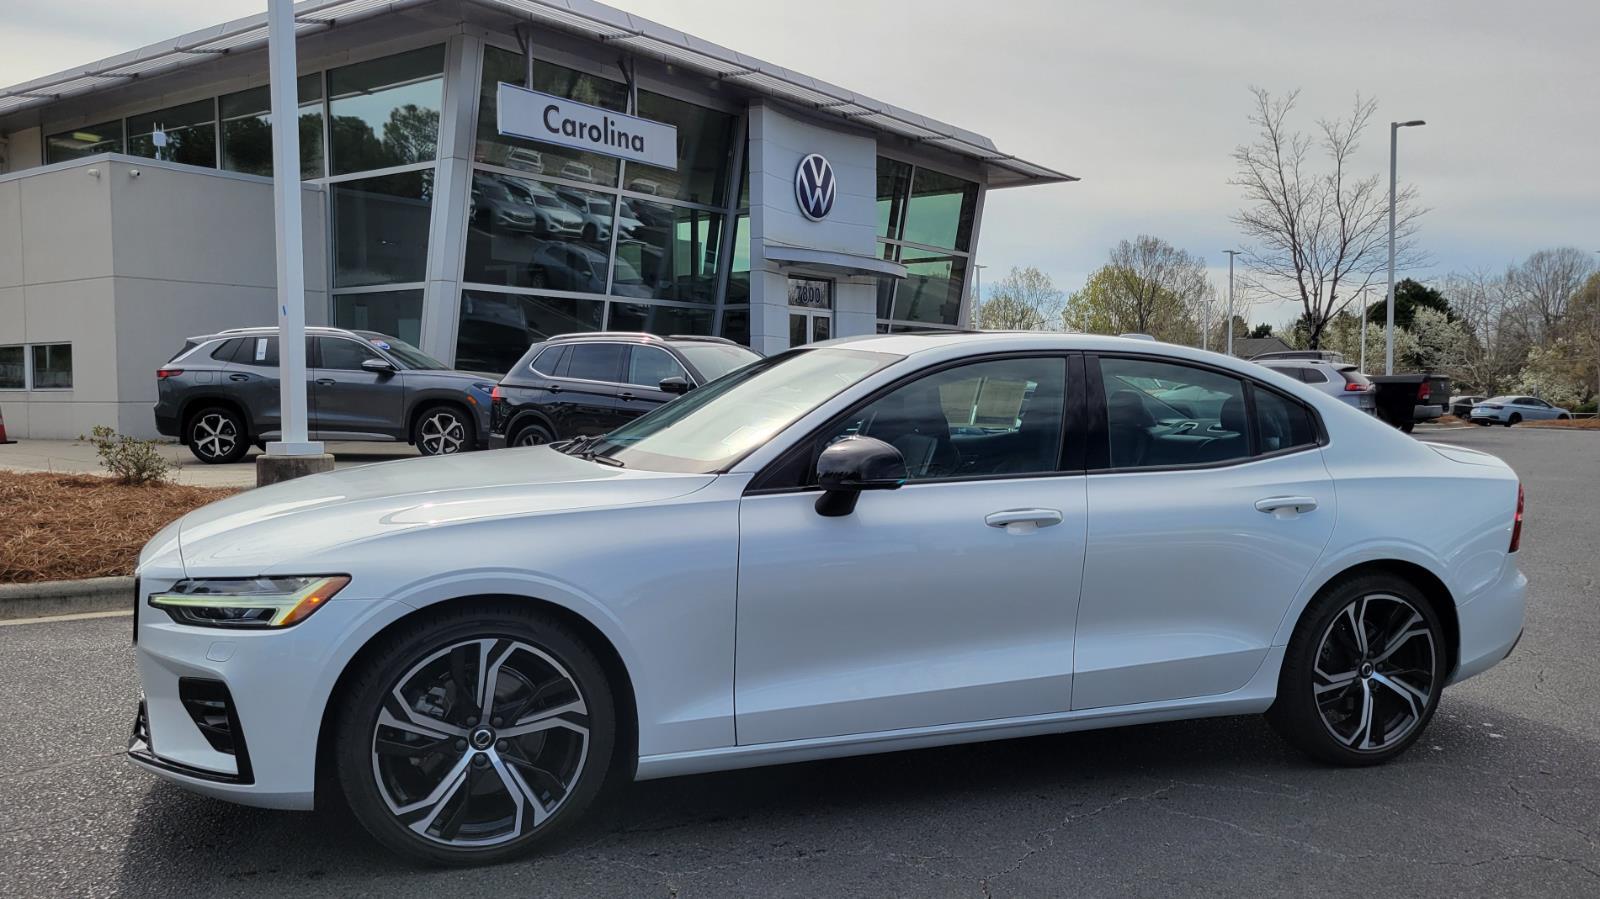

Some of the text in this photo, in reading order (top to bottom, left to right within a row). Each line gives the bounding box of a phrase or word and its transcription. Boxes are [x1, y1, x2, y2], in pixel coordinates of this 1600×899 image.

[543, 104, 644, 153] Carolina
[797, 154, 836, 220] VW
[795, 285, 821, 304] 7800
